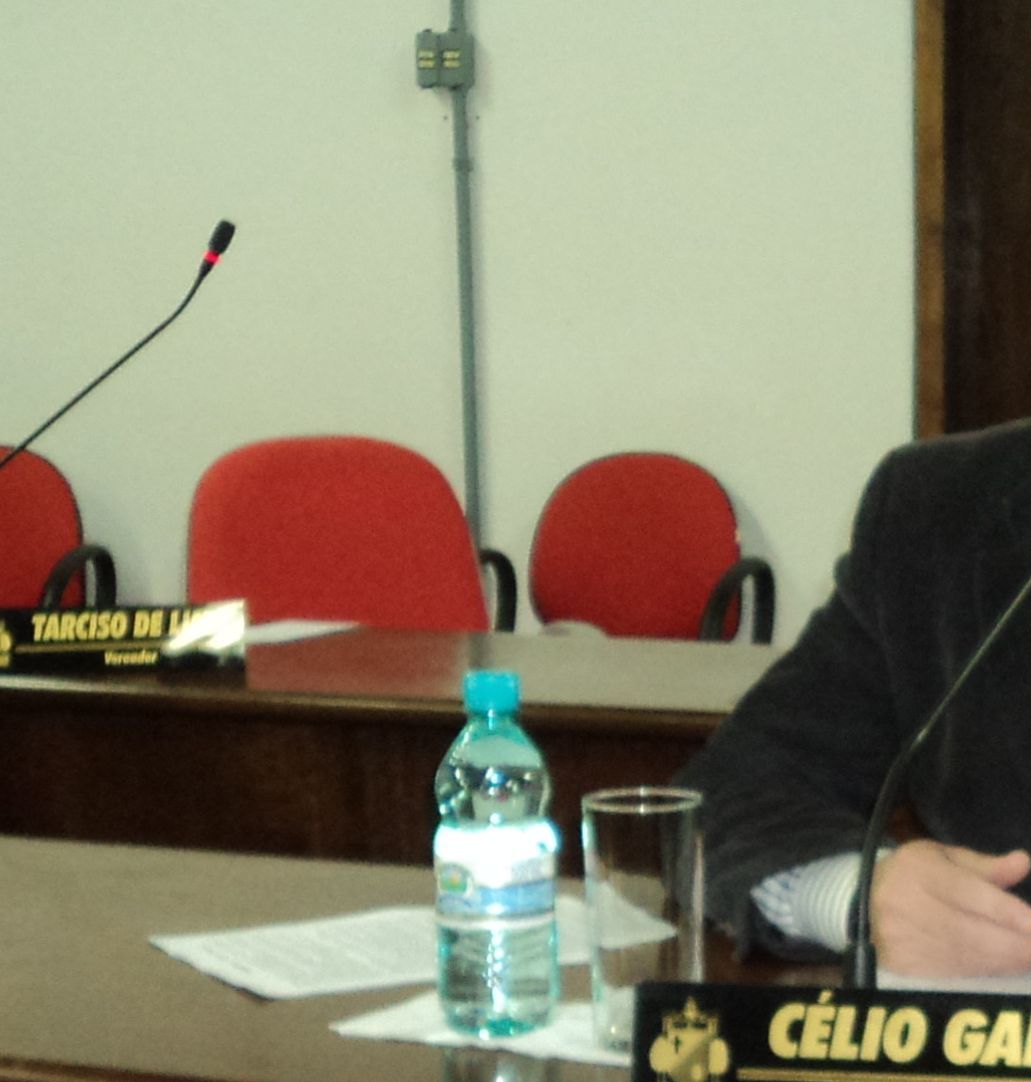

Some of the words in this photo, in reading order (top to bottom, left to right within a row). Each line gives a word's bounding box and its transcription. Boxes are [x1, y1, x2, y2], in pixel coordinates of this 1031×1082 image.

[32, 611, 128, 641] TARCISO
[133, 609, 163, 638] DE
[768, 991, 928, 1063] CÉLIO
